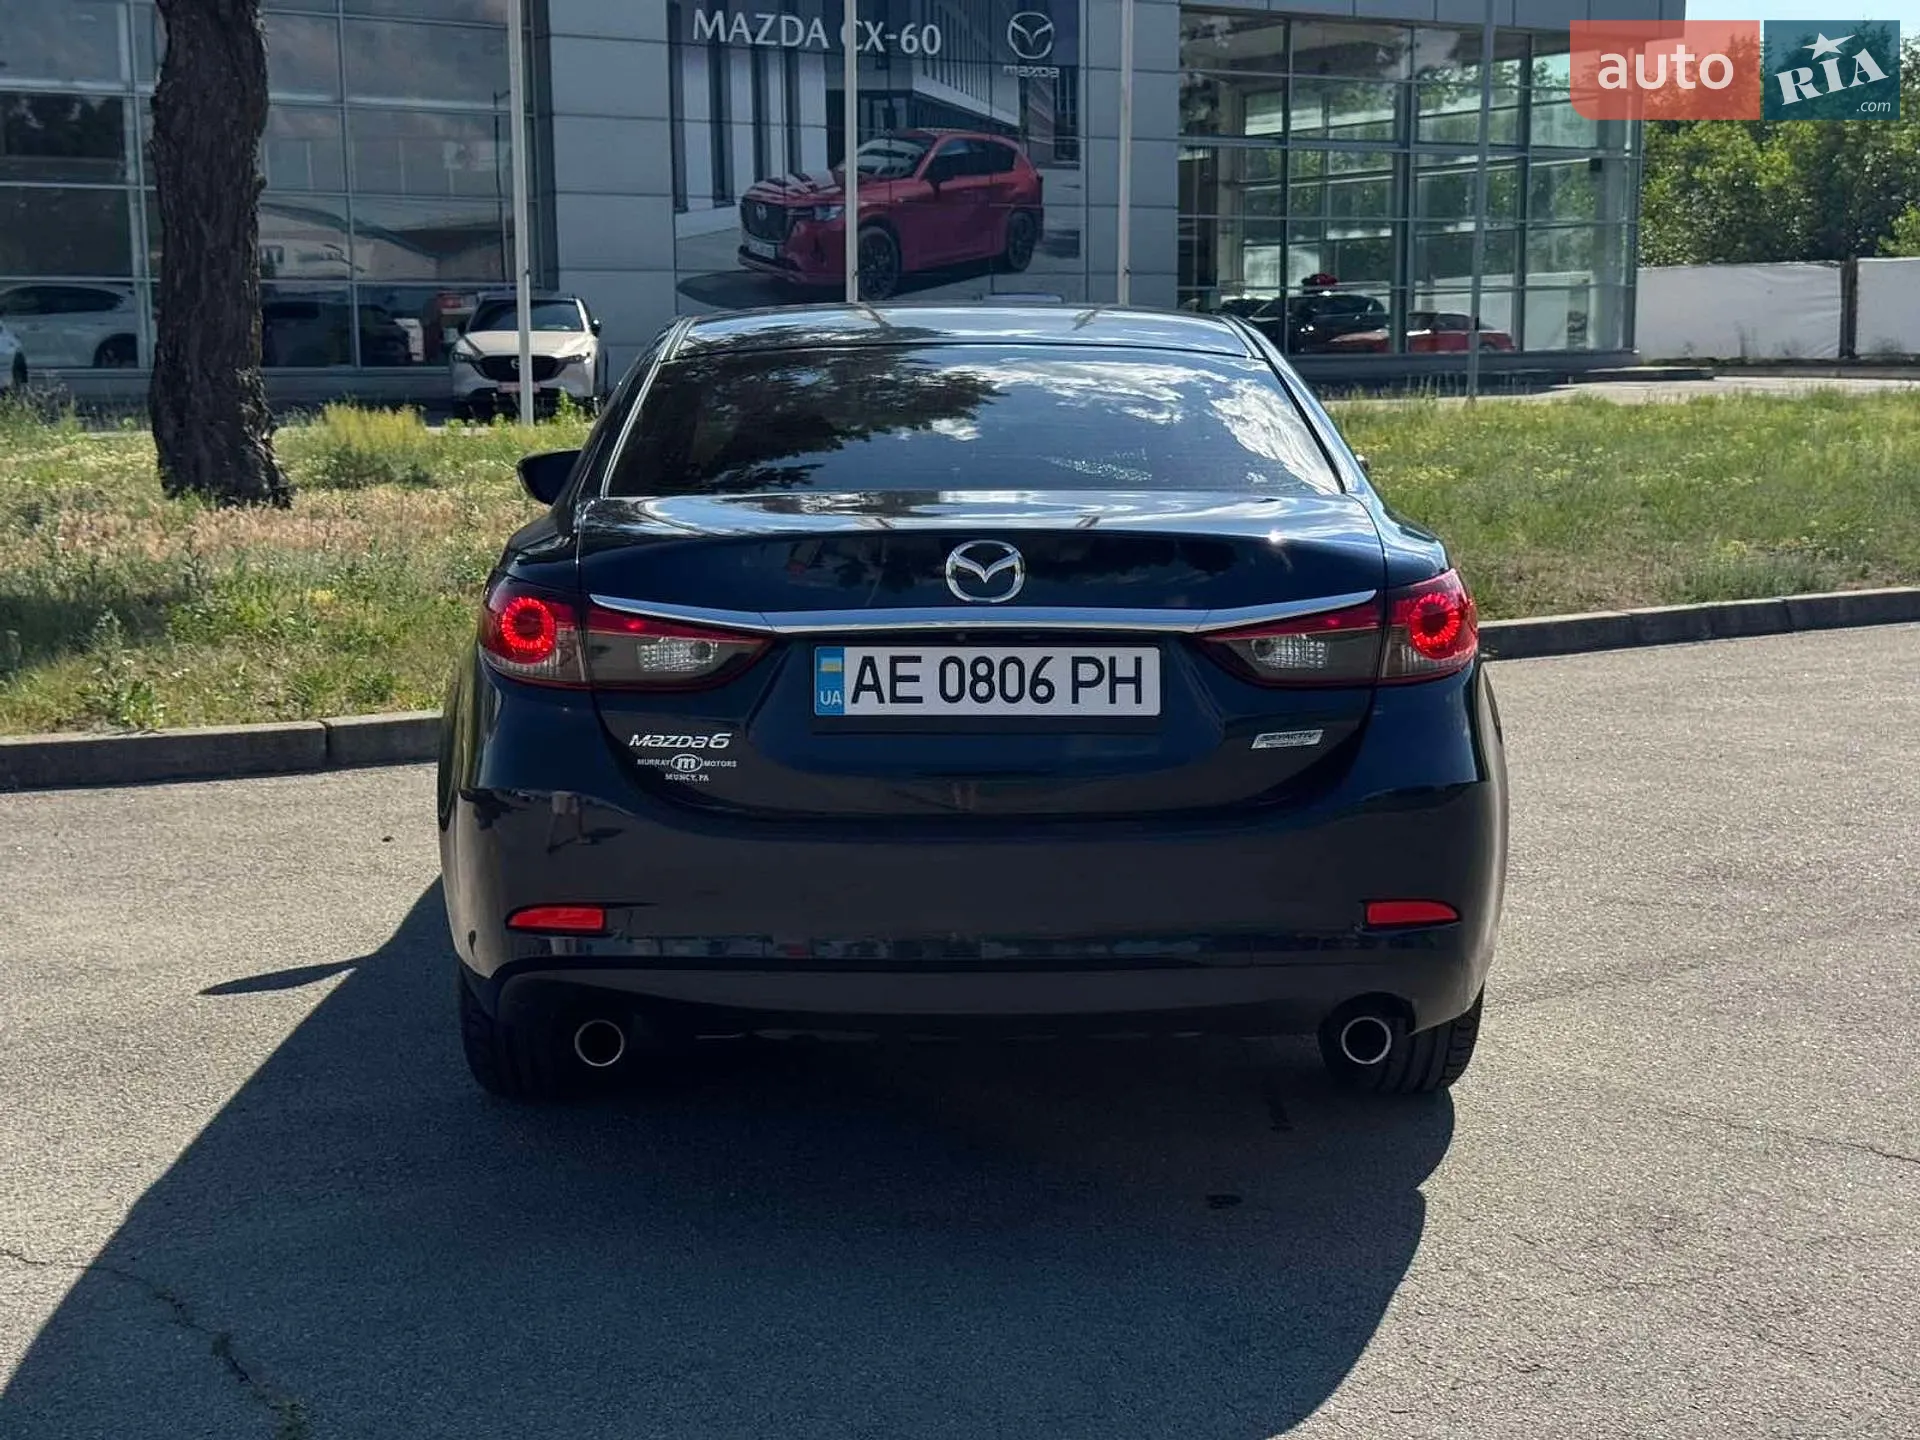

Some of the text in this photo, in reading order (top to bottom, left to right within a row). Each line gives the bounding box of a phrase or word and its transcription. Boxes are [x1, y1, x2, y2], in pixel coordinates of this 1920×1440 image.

[693, 9, 831, 49] MAZDA
[851, 655, 1143, 705] AE 0806 PH
[819, 690, 843, 706] UA
[704, 759, 737, 768] MOTORS
